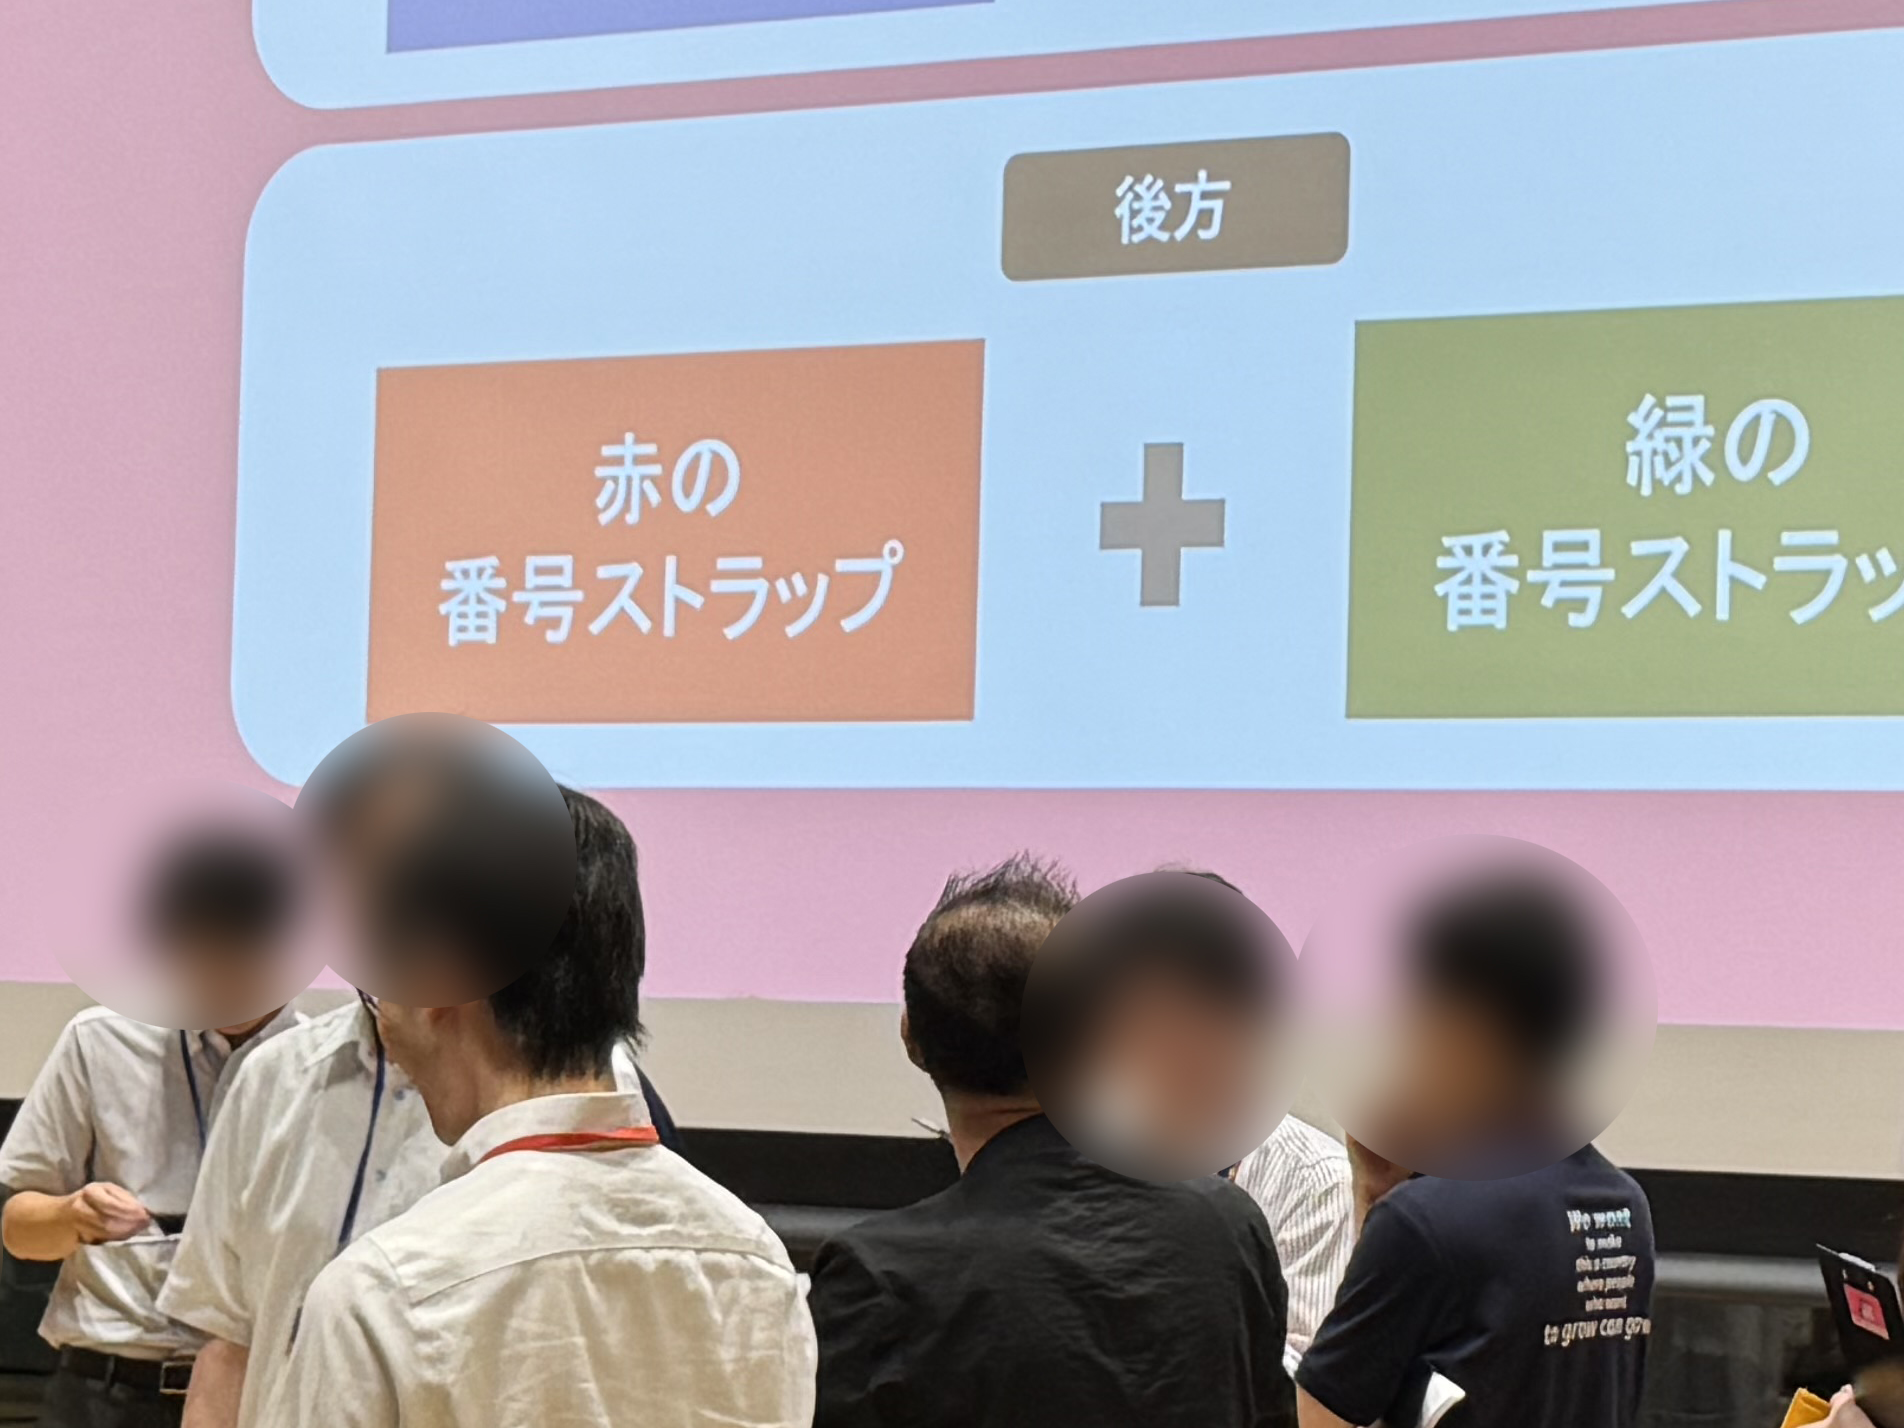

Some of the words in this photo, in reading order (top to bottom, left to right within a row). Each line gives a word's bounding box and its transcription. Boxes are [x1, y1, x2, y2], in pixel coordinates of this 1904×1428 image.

[1114, 169, 1232, 247] 後方
[592, 431, 742, 528] 赤の
[1624, 390, 1812, 498] 緑の
[438, 537, 904, 648] 番号ストラップ
[1561, 1320, 1598, 1348] grow
